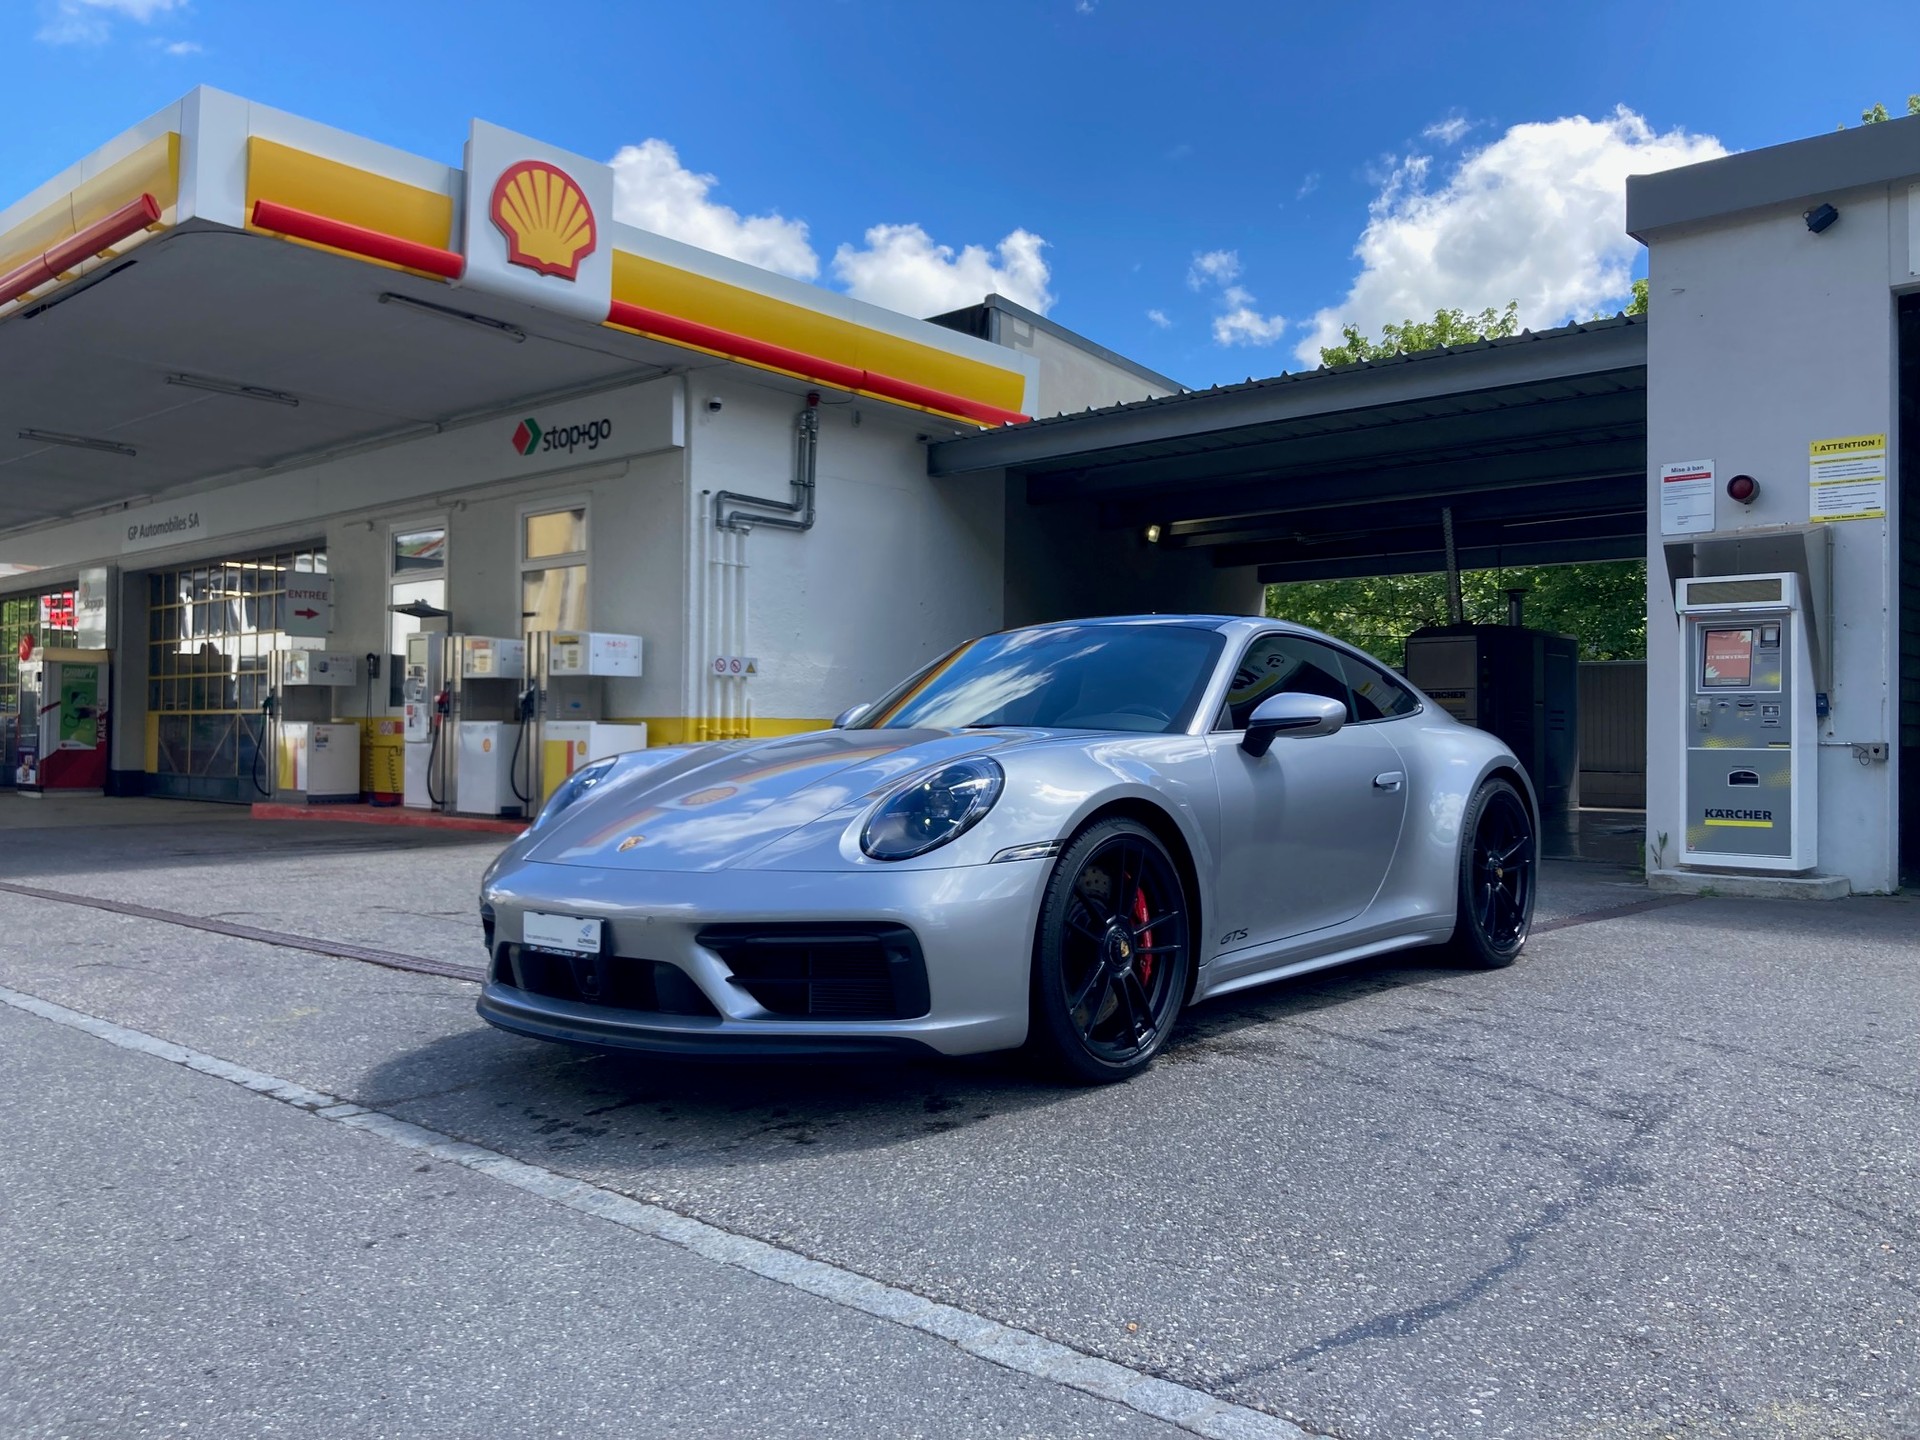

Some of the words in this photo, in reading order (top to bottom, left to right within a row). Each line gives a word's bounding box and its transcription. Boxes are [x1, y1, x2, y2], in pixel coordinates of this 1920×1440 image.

[542, 418, 611, 455] stop+go
[1820, 440, 1875, 451] ATTENTION
[128, 526, 138, 541] GP
[140, 516, 187, 538] Automobiles
[188, 512, 200, 529] SA
[288, 588, 328, 601] ENTRÉE
[1704, 808, 1772, 820] KÄRCHER
[1220, 928, 1248, 945] GTS
